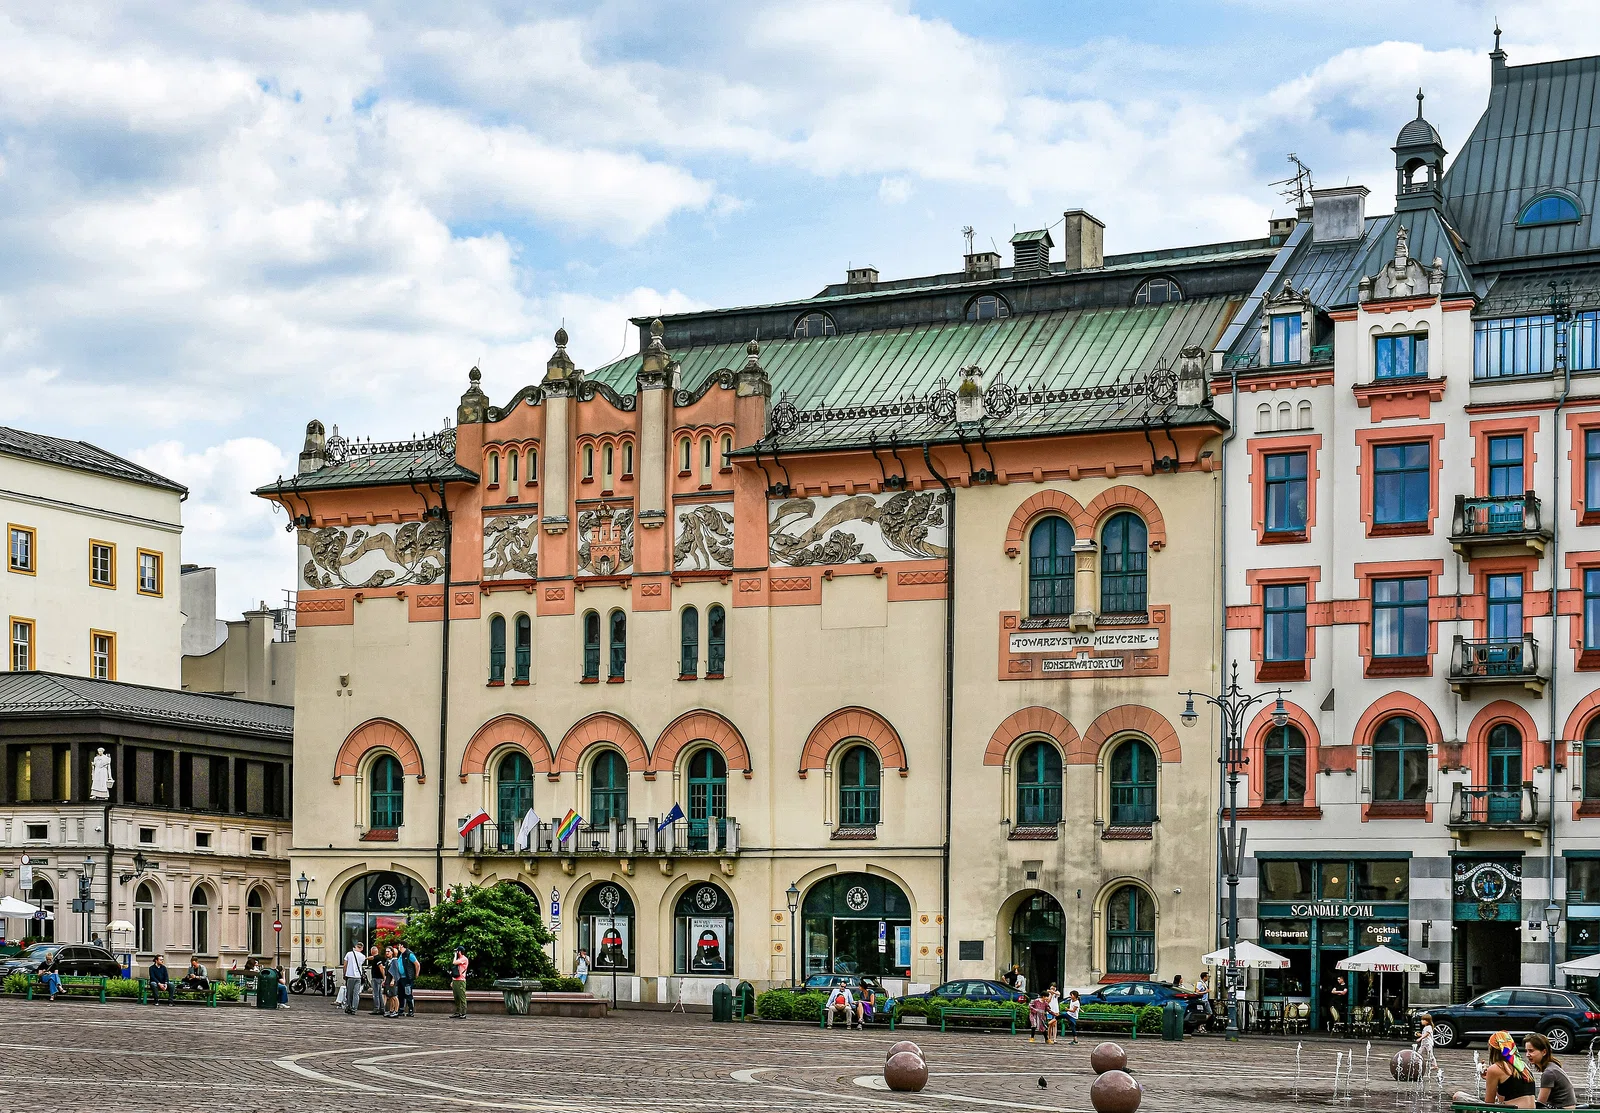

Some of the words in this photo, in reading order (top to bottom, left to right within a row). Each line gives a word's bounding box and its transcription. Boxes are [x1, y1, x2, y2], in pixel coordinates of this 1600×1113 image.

[1043, 659, 1124, 670] KONSERWATORYUM
[552, 904, 558, 914] P
[1291, 905, 1340, 917] SCANDALE
[1342, 905, 1374, 917] ROYAL
[1264, 929, 1308, 938] Restaurant
[1376, 935, 1392, 943] Bar
